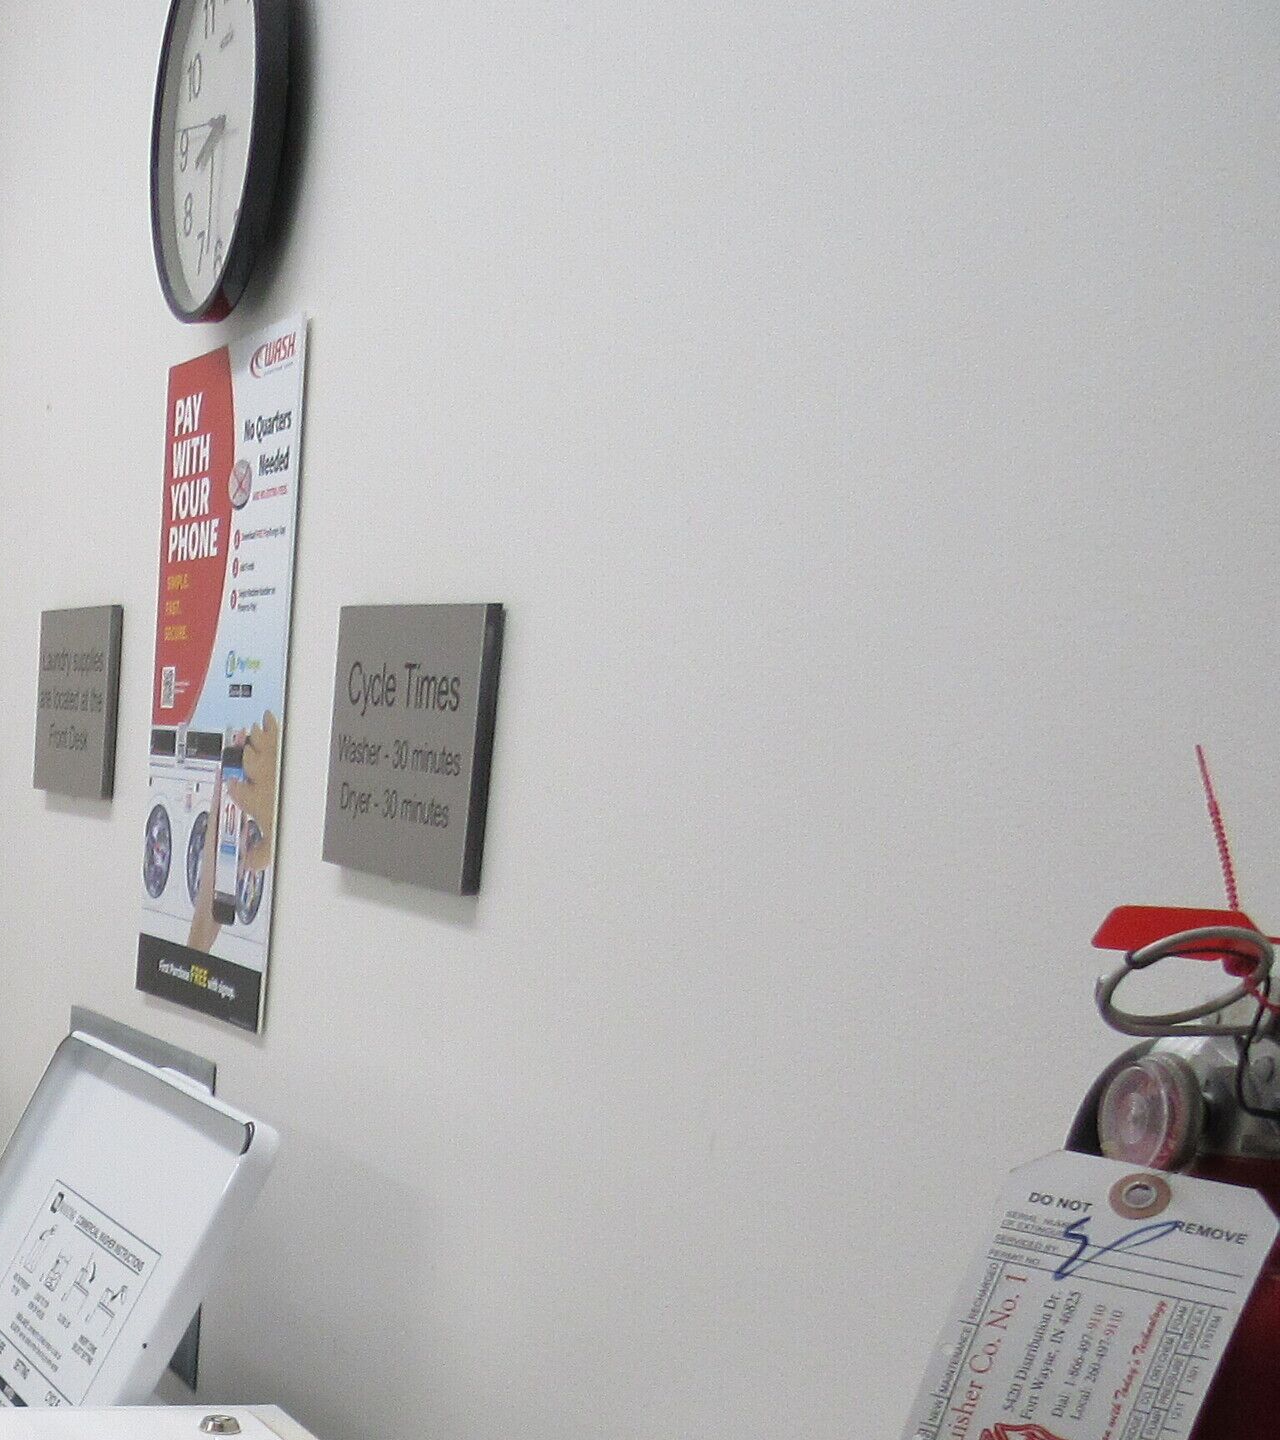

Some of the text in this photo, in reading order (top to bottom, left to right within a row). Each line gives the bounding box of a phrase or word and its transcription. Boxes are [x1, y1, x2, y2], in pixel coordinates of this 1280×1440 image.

[187, 52, 202, 102] 10
[181, 130, 189, 173] 9
[183, 192, 193, 237] 8
[196, 230, 205, 275] 7
[175, 392, 203, 437] PAY
[244, 410, 292, 443] No Quarters
[173, 433, 211, 479] WITH
[259, 446, 290, 476] Needed
[171, 477, 211, 521] YOUR
[168, 518, 220, 563] PHONE
[348, 661, 461, 716] Cycle Times
[338, 734, 382, 766] Washer
[392, 739, 408, 771] 30
[410, 742, 462, 777] minutes
[340, 782, 371, 819] Dryer
[381, 790, 397, 819] 30
[401, 794, 450, 829] minutes
[1029, 1192, 1093, 1212] DO NOT
[1177, 1221, 1246, 1244] REMOVE
[968, 1262, 998, 1319] RECHARGED
[968, 1338, 1001, 1373] Co.
[985, 1294, 1019, 1329] No.
[1014, 1313, 1051, 1380] Distribution
[1131, 1301, 1166, 1354] Technology
[939, 1329, 970, 1393] MAINTENANCE
[1019, 1395, 1039, 1420] Fort
[1030, 1350, 1058, 1389] Wayne,
[1049, 1329, 1065, 1343] IN
[1113, 1359, 1140, 1399] Today's
[1108, 1403, 1121, 1427] with
